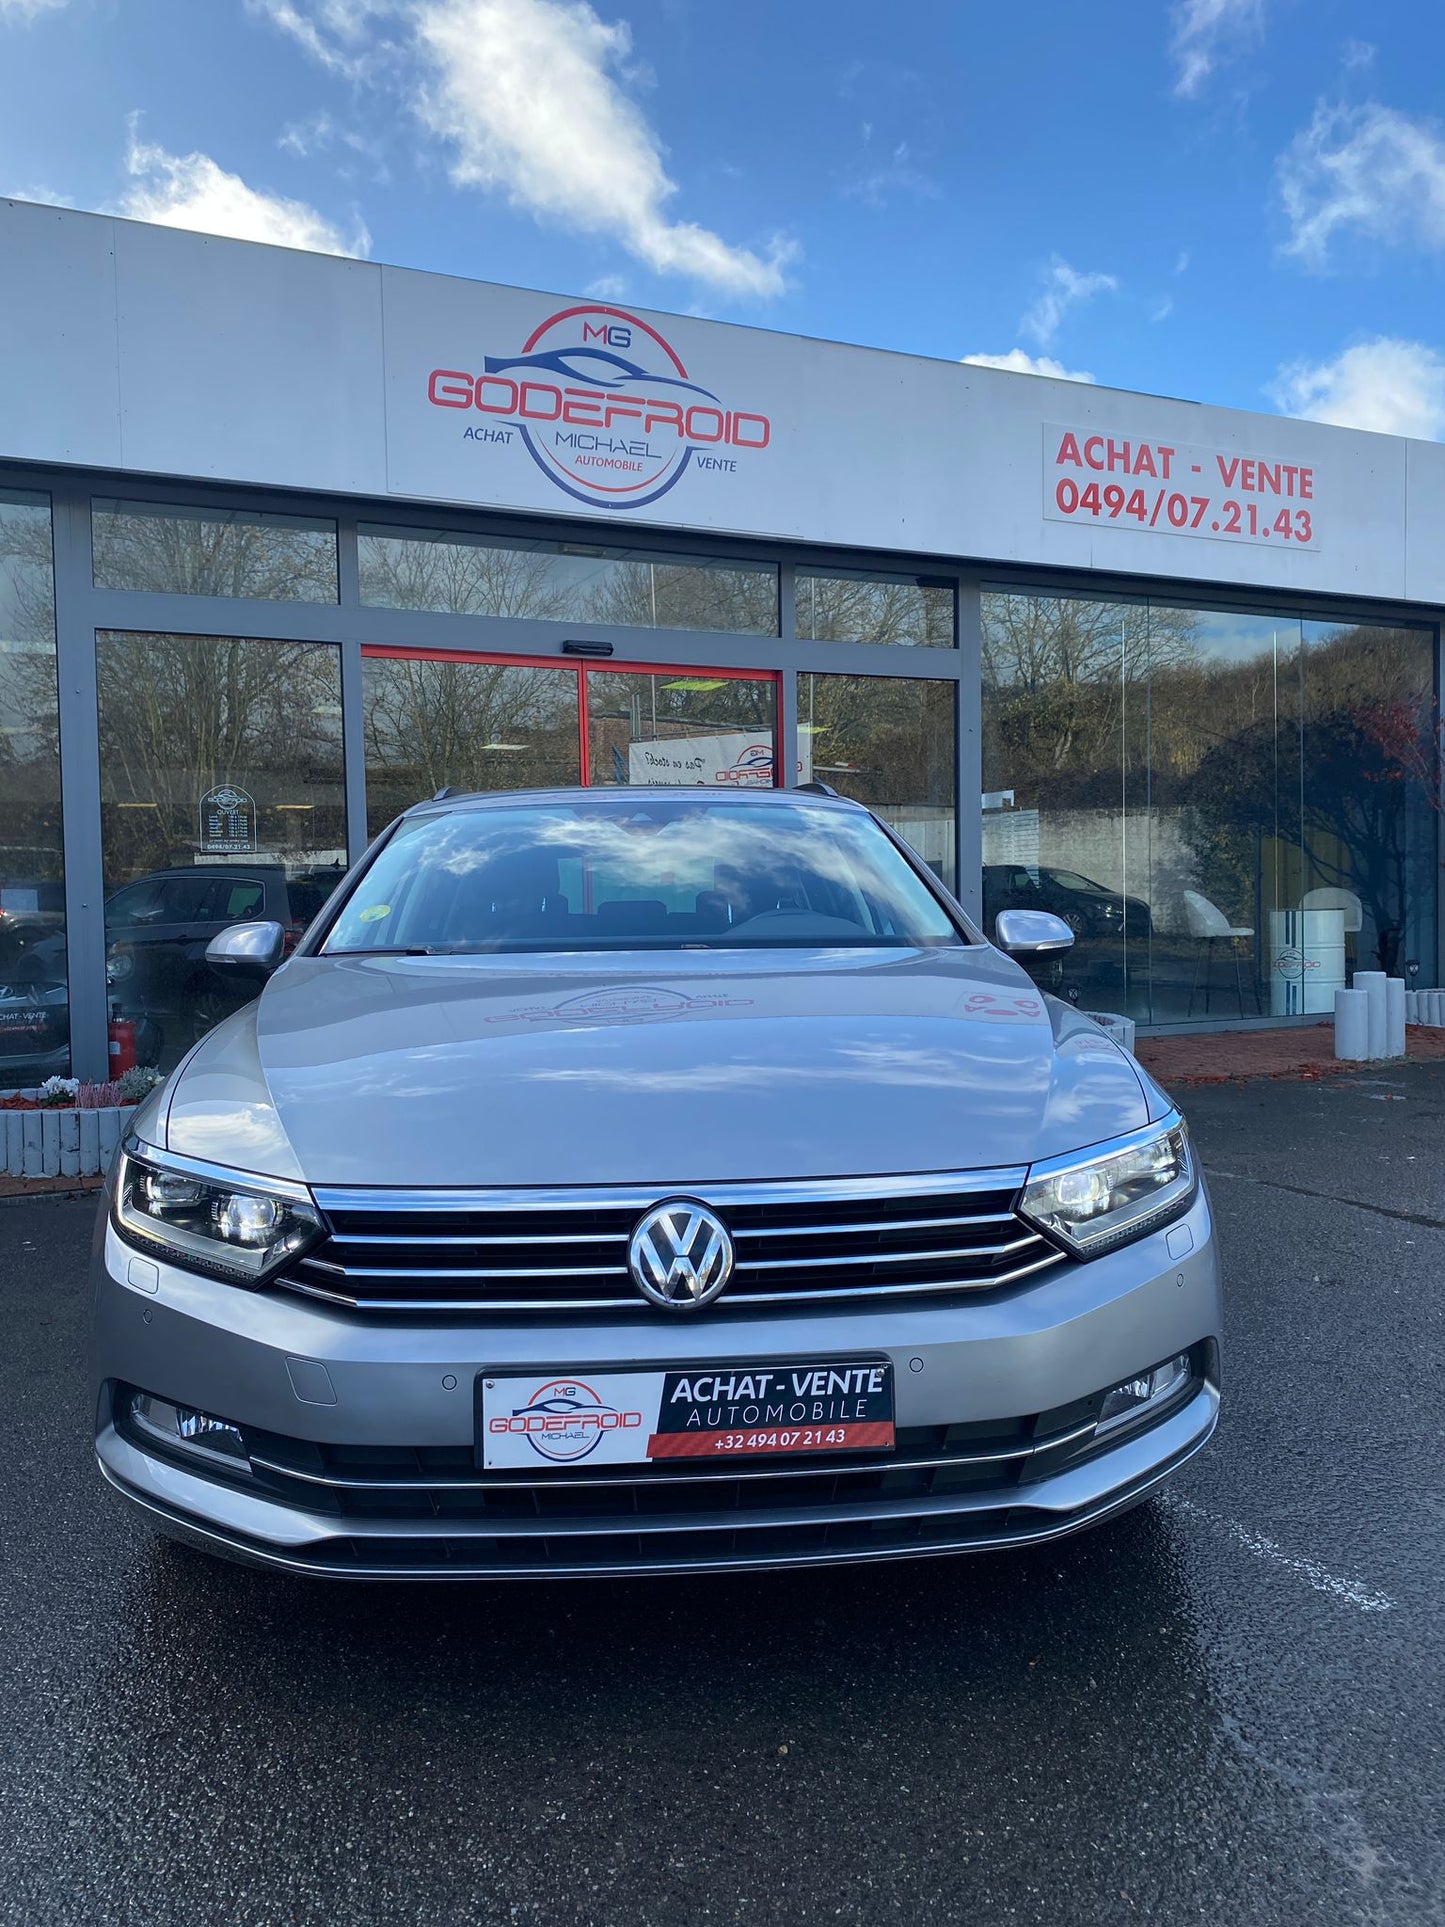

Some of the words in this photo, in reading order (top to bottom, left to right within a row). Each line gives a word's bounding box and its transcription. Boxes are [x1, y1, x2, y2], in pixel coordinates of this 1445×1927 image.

[583, 321, 632, 348] MG
[428, 369, 770, 449] GODEFROID
[463, 427, 514, 444] ACHAT
[555, 431, 662, 459] MICHAEL
[574, 455, 643, 472] AUTOMOBILE
[696, 456, 737, 472] VENTE
[1056, 432, 1175, 479] ACHAT
[1216, 455, 1313, 499] VENTE
[1055, 478, 1312, 542] 0494/07.21.43
[553, 1387, 576, 1397] MG
[670, 1373, 774, 1403] ACHAT
[792, 1369, 883, 1396] VENTE
[489, 1412, 642, 1433] GODEFROID
[686, 1399, 868, 1427] AUTOMOBILE
[541, 1431, 590, 1440] MICHAEL
[714, 1435, 743, 1449] +32
[747, 1433, 777, 1448] 494
[780, 1431, 800, 1446] 07
[803, 1431, 822, 1444] 21
[825, 1429, 846, 1443] 43
